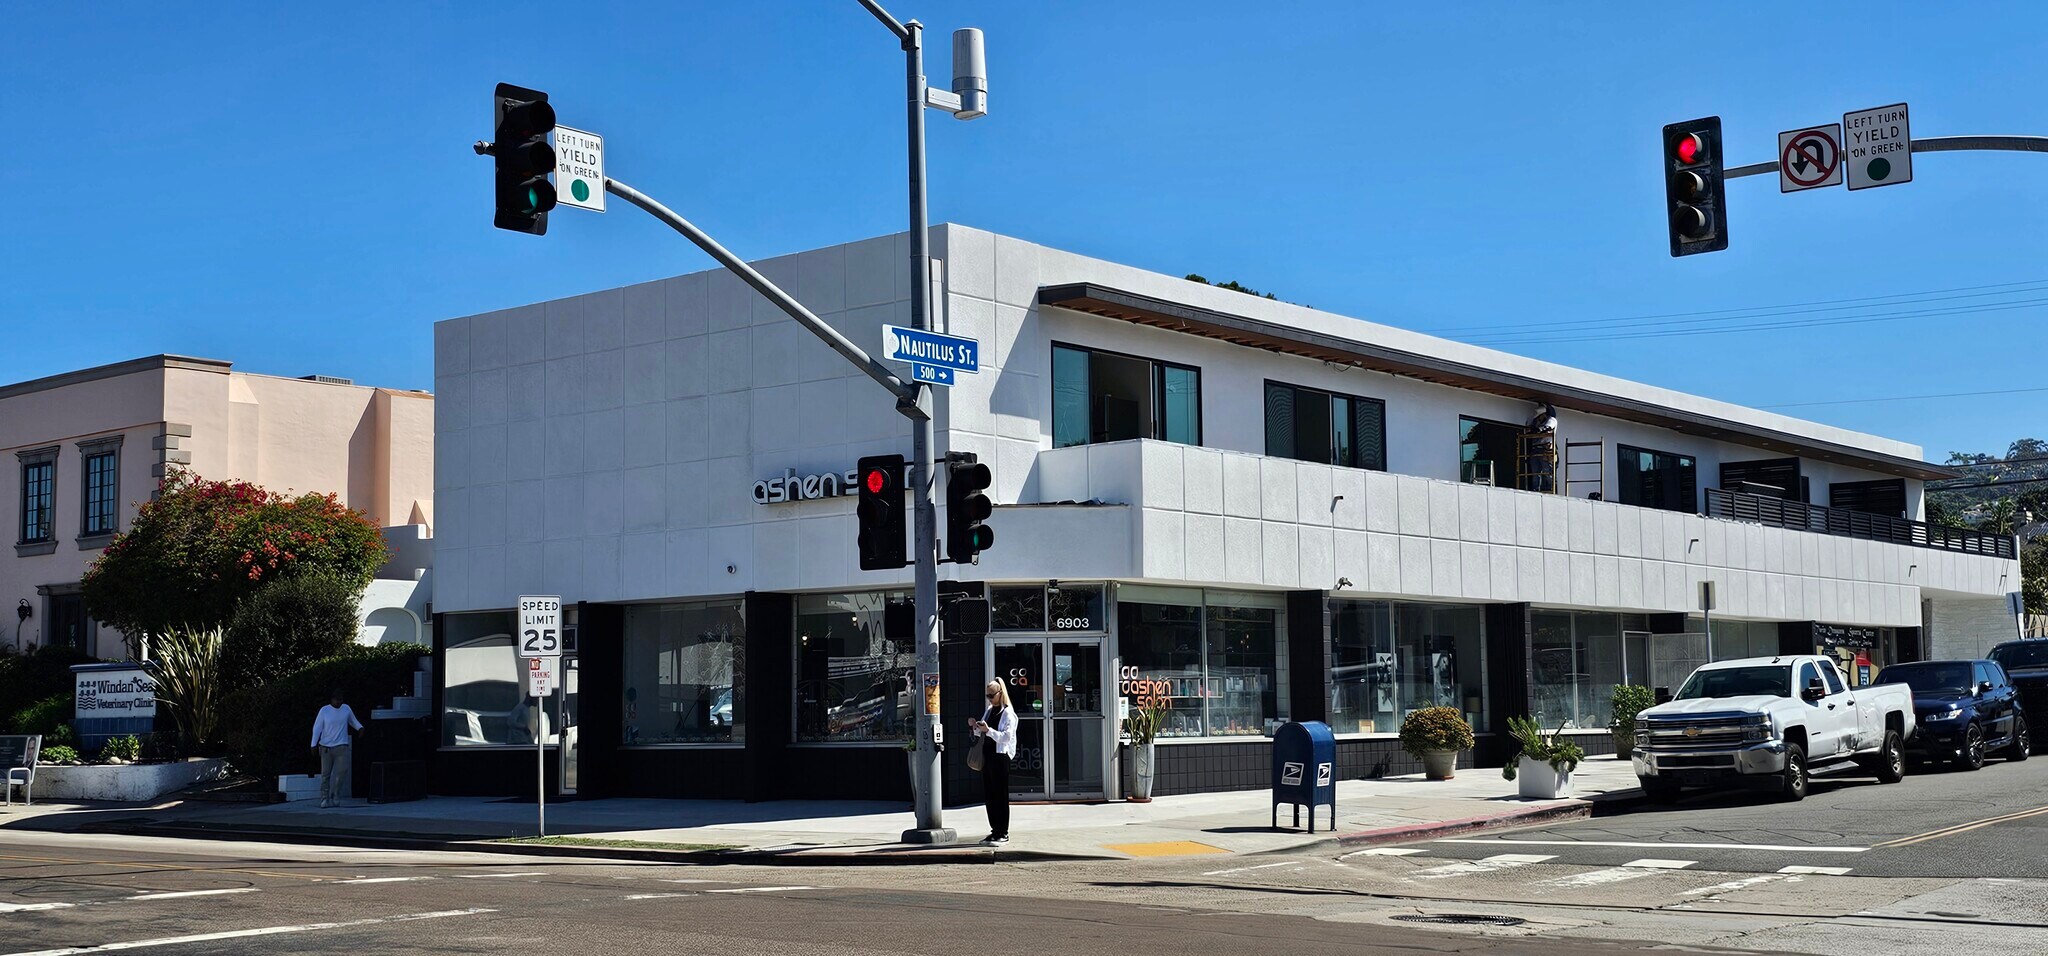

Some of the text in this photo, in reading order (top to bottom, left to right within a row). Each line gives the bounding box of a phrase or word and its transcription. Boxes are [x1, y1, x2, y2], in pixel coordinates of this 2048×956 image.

[1847, 110, 1905, 129] LEFT TURN
[556, 133, 601, 151] LEFT TURN
[1854, 126, 1899, 143] YIELD
[561, 147, 596, 166] YIELD
[1853, 142, 1902, 158] ON GREEN
[561, 163, 599, 179] ON GREEN
[900, 334, 954, 362] NAUTILUS
[920, 366, 935, 380] 500
[751, 467, 840, 504] ashen
[522, 601, 559, 611] SPEED
[525, 615, 555, 625] LIMIT
[1056, 617, 1090, 629] 6903
[524, 629, 557, 651] 25
[97, 680, 133, 694] Windan
[97, 698, 153, 711] Veterinary Clinic
